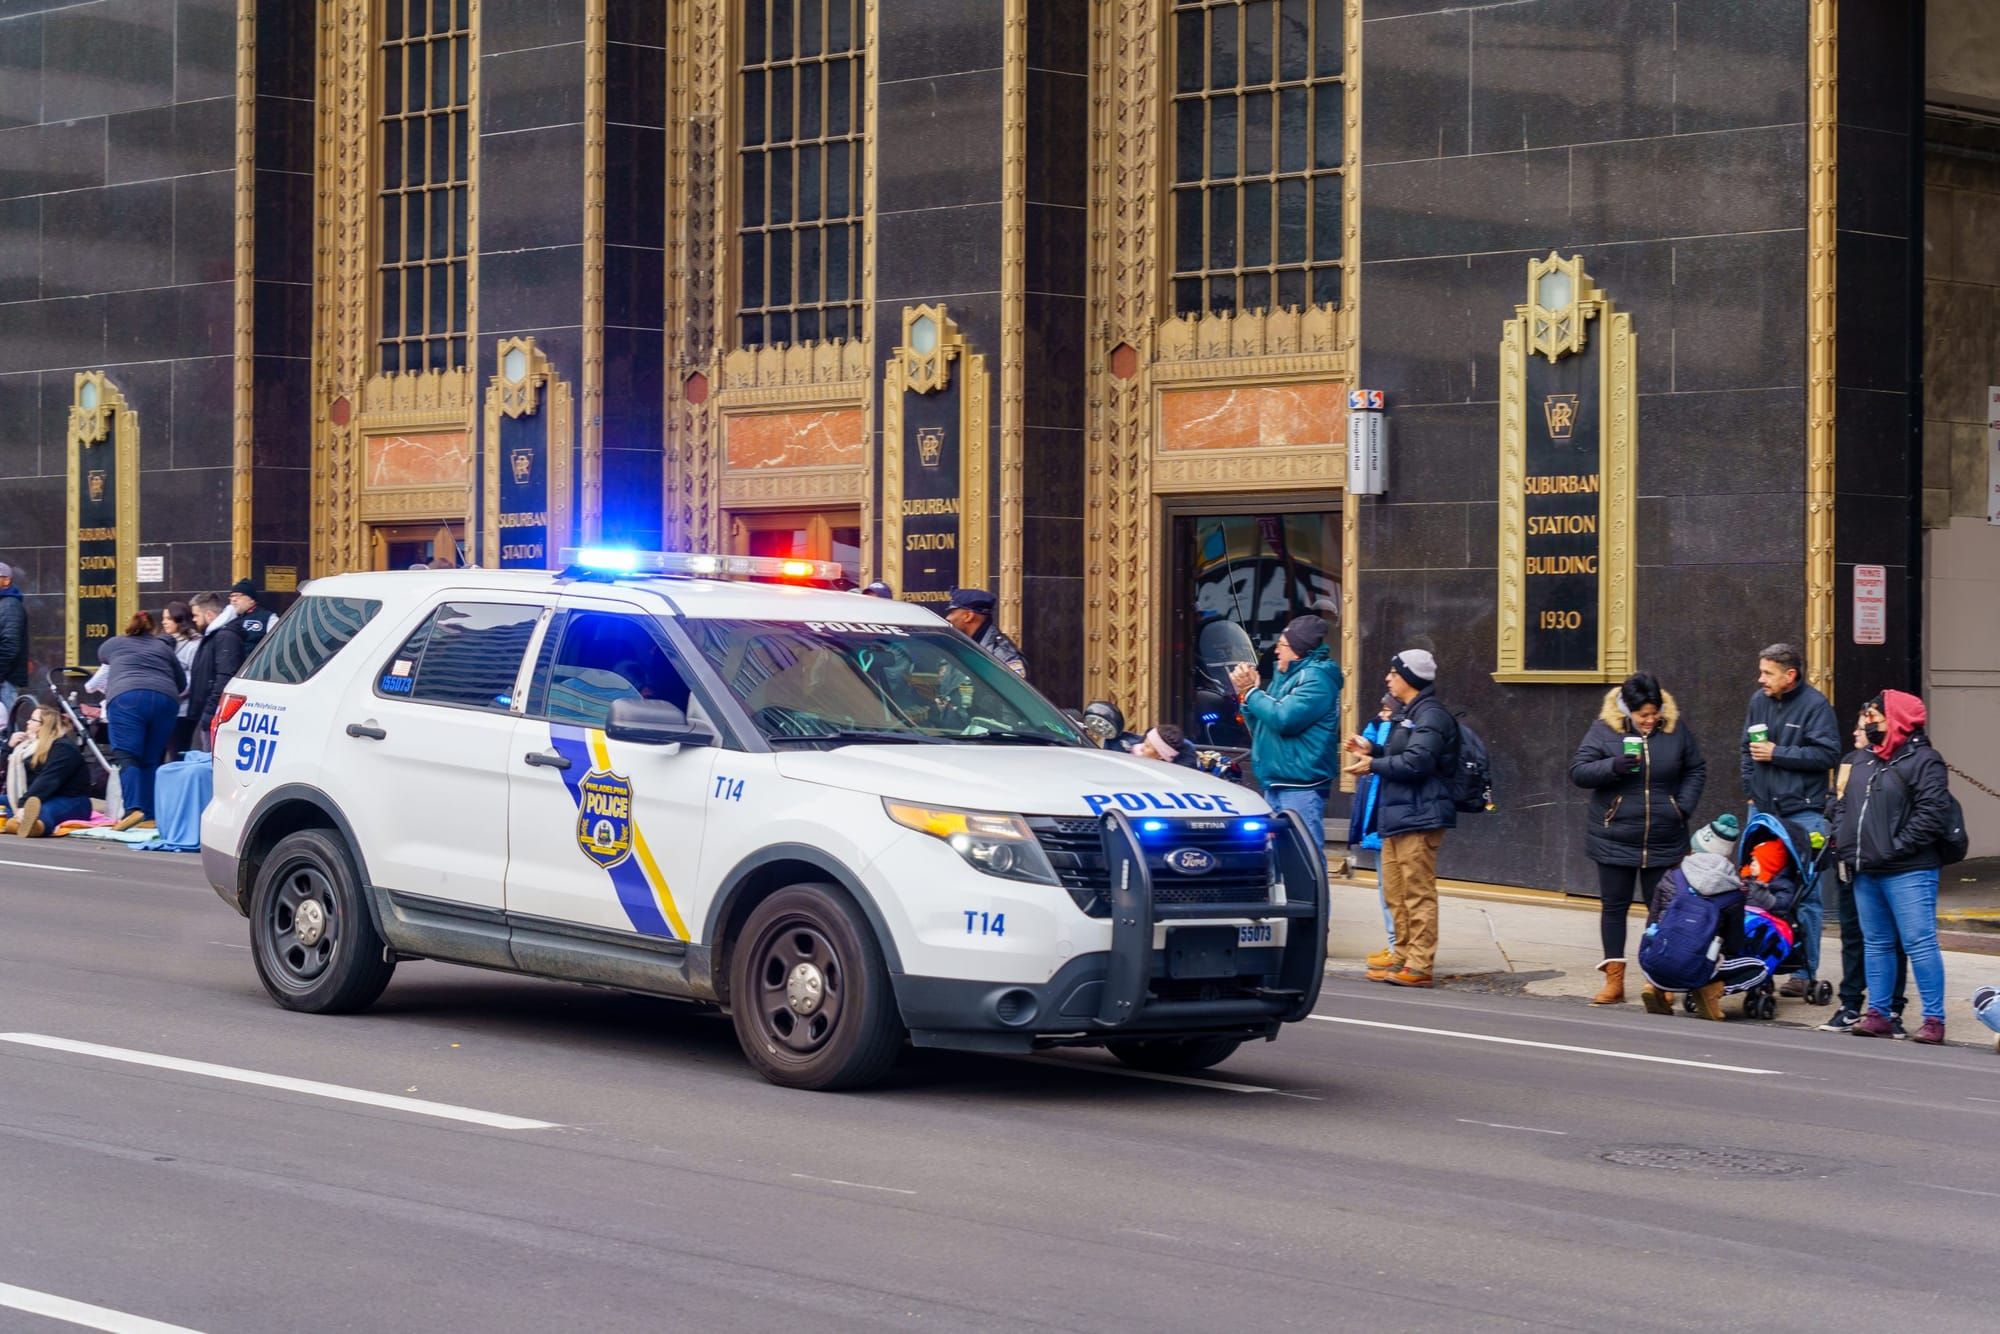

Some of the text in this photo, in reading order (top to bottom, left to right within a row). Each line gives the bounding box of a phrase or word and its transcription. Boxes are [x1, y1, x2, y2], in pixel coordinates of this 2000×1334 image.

[1525, 474, 1599, 495] SUBURBAN
[902, 498, 960, 516] SUBURBAN
[498, 512, 548, 528] SUBURBAN
[1527, 515, 1596, 535] STATION
[79, 527, 116, 541] SUBURBAN
[905, 533, 955, 551] STATION
[502, 544, 544, 560] STATION
[80, 556, 116, 570] STATION
[1525, 555, 1597, 575] BUILDING
[1540, 610, 1582, 629] 1930
[86, 624, 108, 637] 1930
[804, 621, 911, 637] POLICE
[238, 711, 280, 736] DIAL
[235, 736, 277, 773] 911
[586, 782, 628, 795] PHILADELPHIA
[715, 776, 744, 801] T14
[586, 792, 628, 819] POLICE
[1081, 792, 1241, 816] POLICE
[1191, 821, 1226, 830] SETINA
[1181, 851, 1208, 868] Ford
[964, 911, 1004, 936] T14
